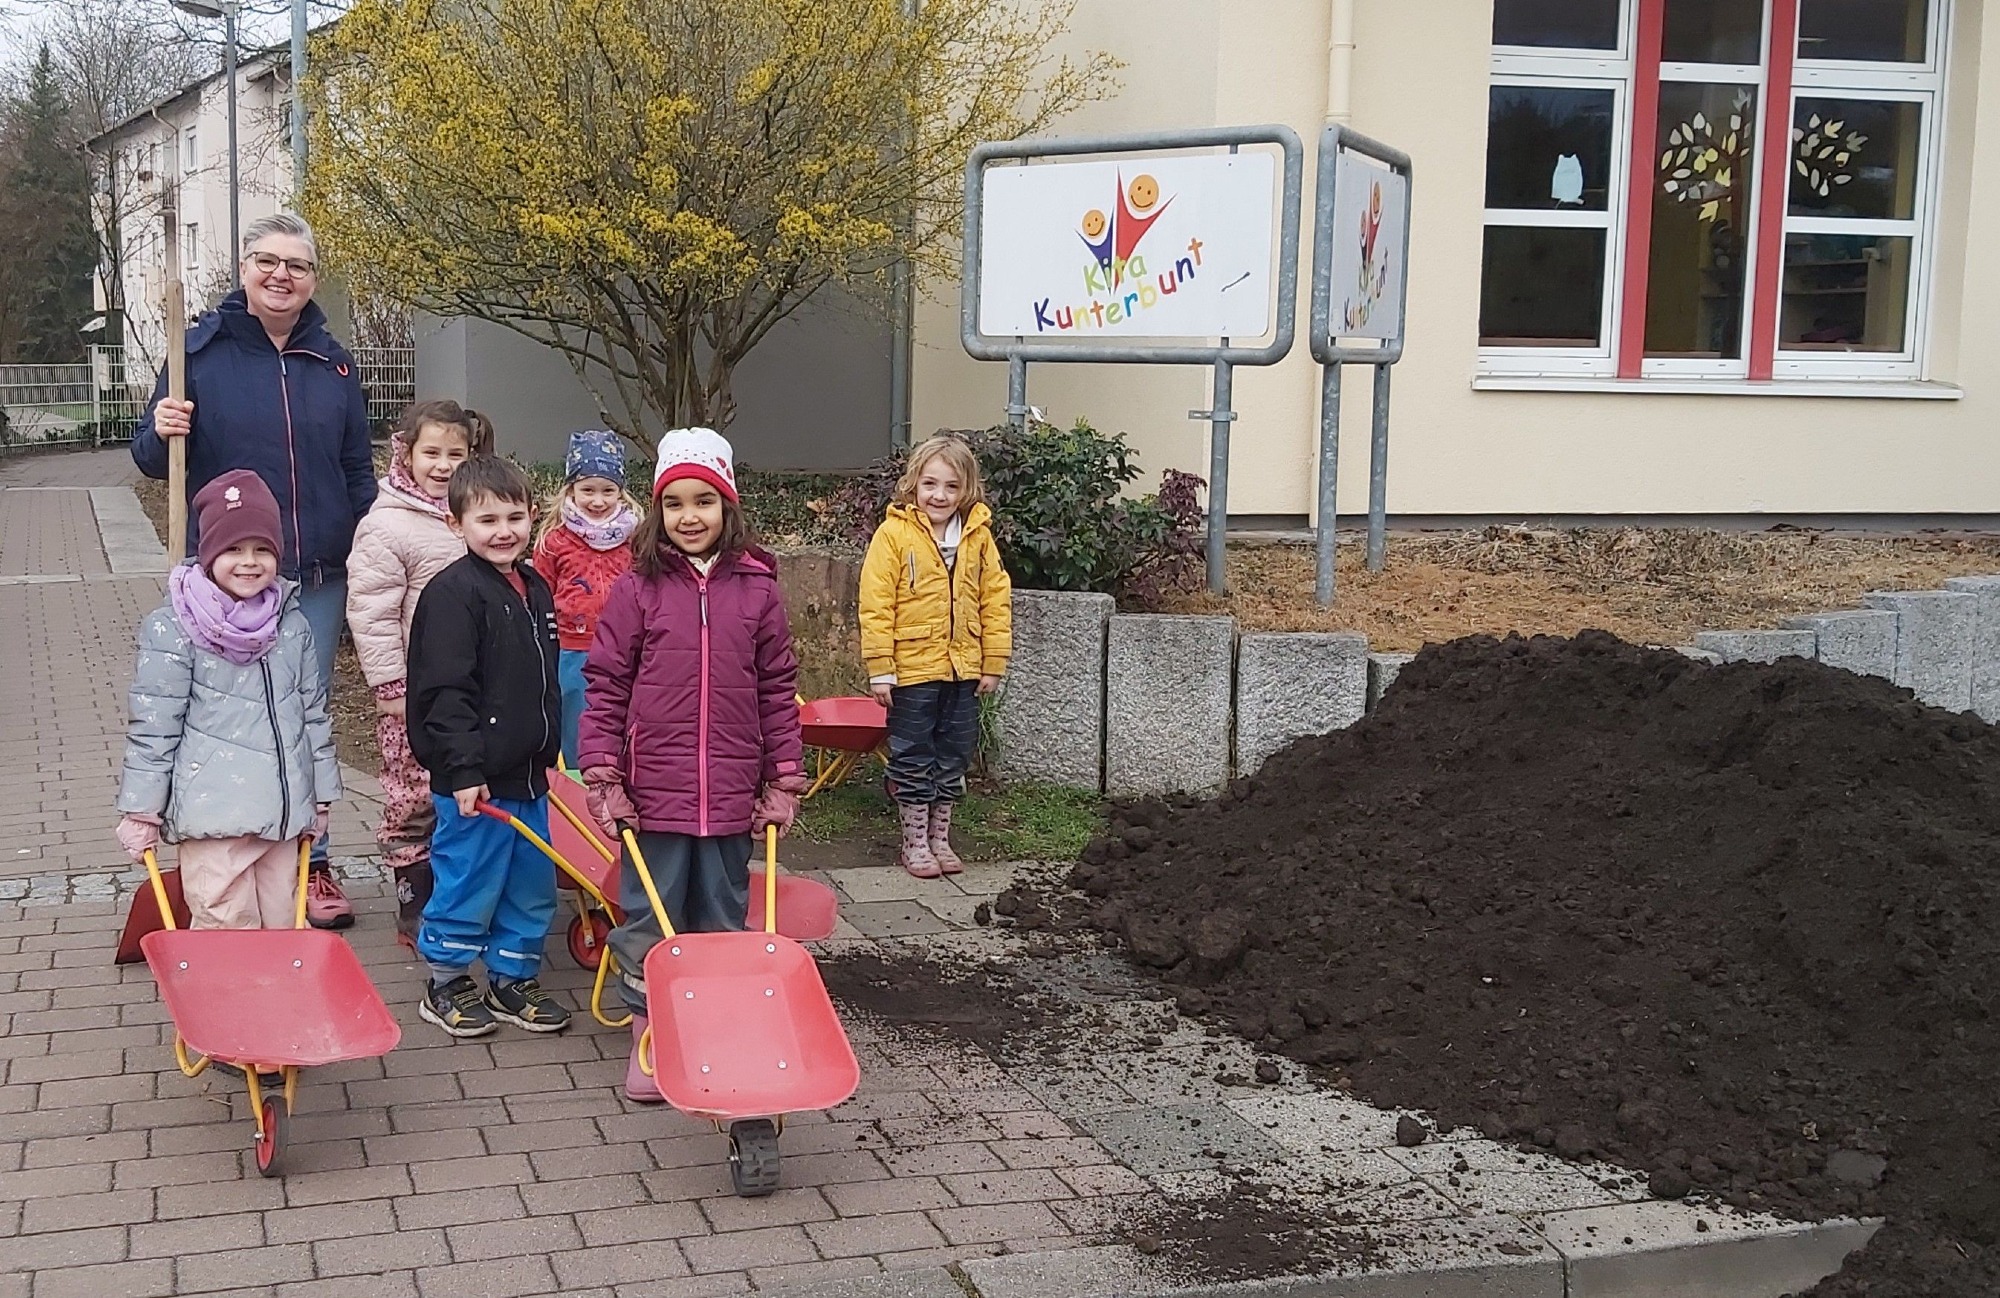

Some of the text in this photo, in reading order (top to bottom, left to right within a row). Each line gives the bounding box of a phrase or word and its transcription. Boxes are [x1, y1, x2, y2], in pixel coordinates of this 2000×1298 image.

[1034, 237, 1203, 332] Kunterbunt
[1083, 255, 1147, 296] Kita
[1344, 247, 1389, 333] Kuterunt
